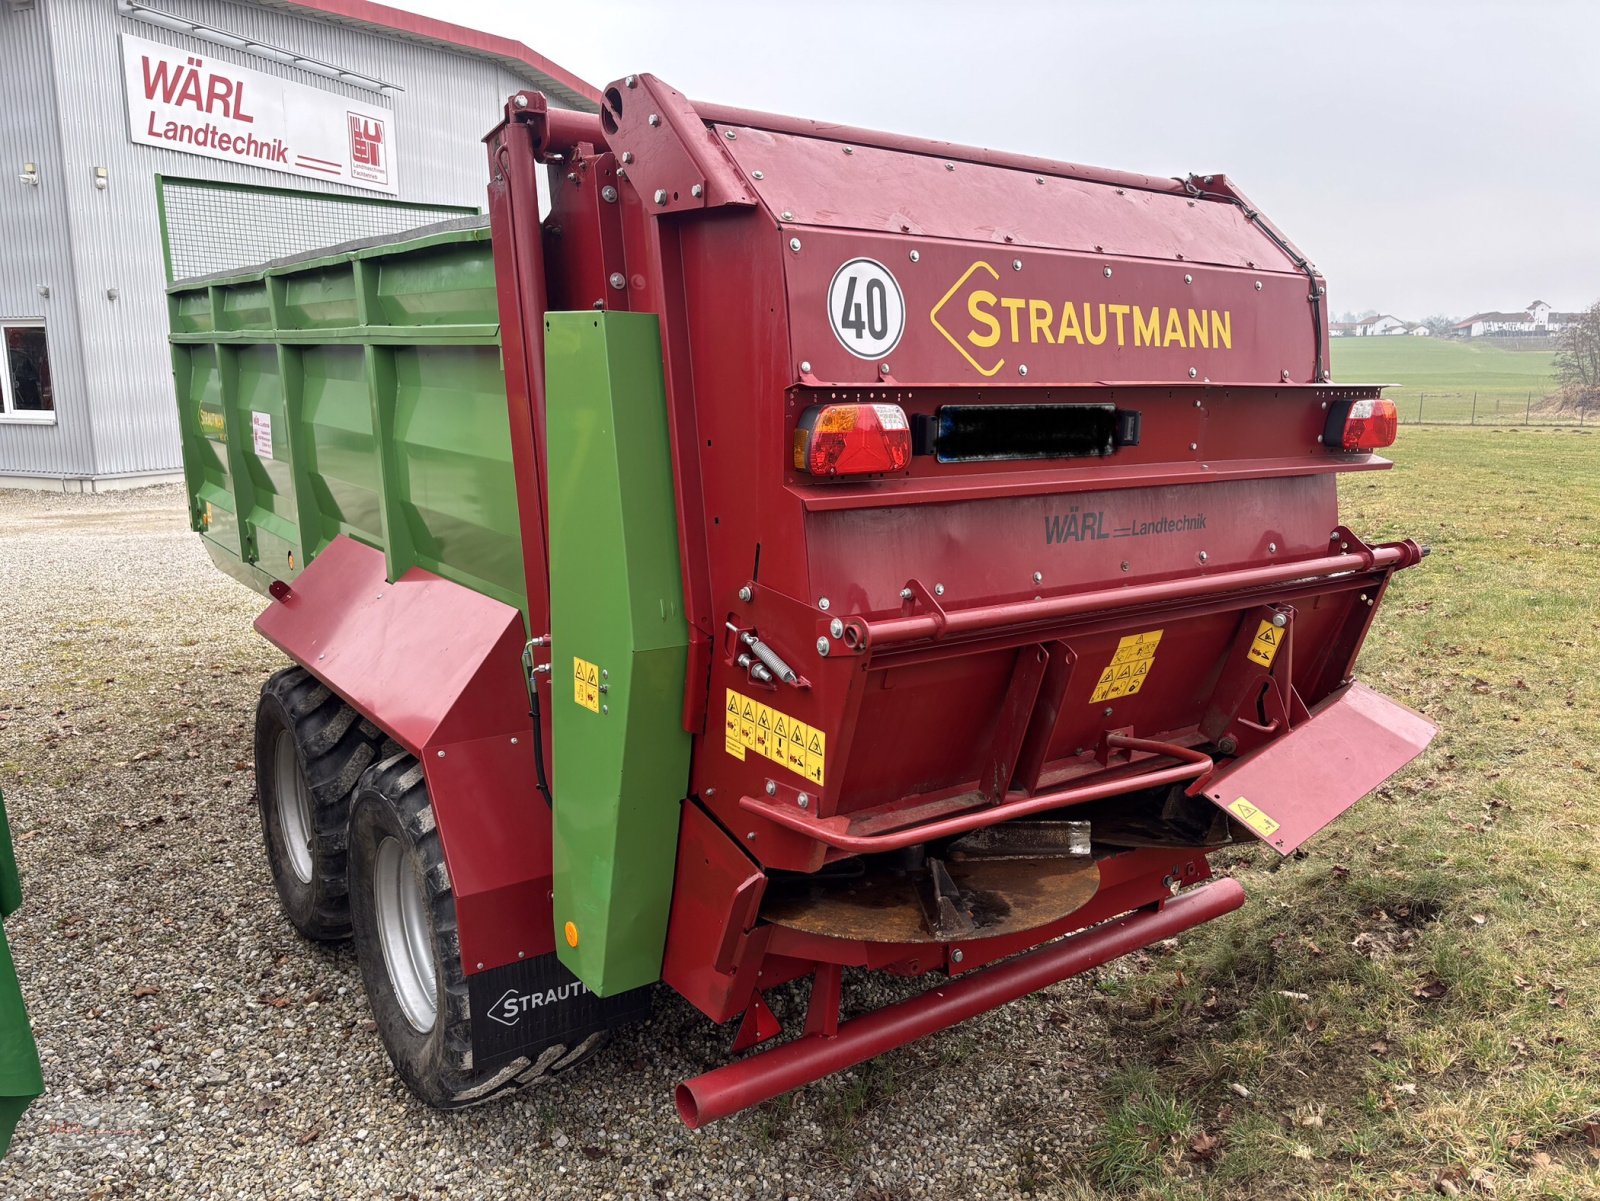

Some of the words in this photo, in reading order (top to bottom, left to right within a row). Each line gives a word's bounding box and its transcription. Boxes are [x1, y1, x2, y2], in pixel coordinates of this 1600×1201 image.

[142, 55, 254, 123] WÄRL
[147, 110, 289, 164] Landtechnik
[841, 276, 889, 341] 40
[967, 289, 1232, 350] STRAUTMANN
[1044, 506, 1110, 545] WÄRL
[1131, 513, 1207, 537] Landtechnik
